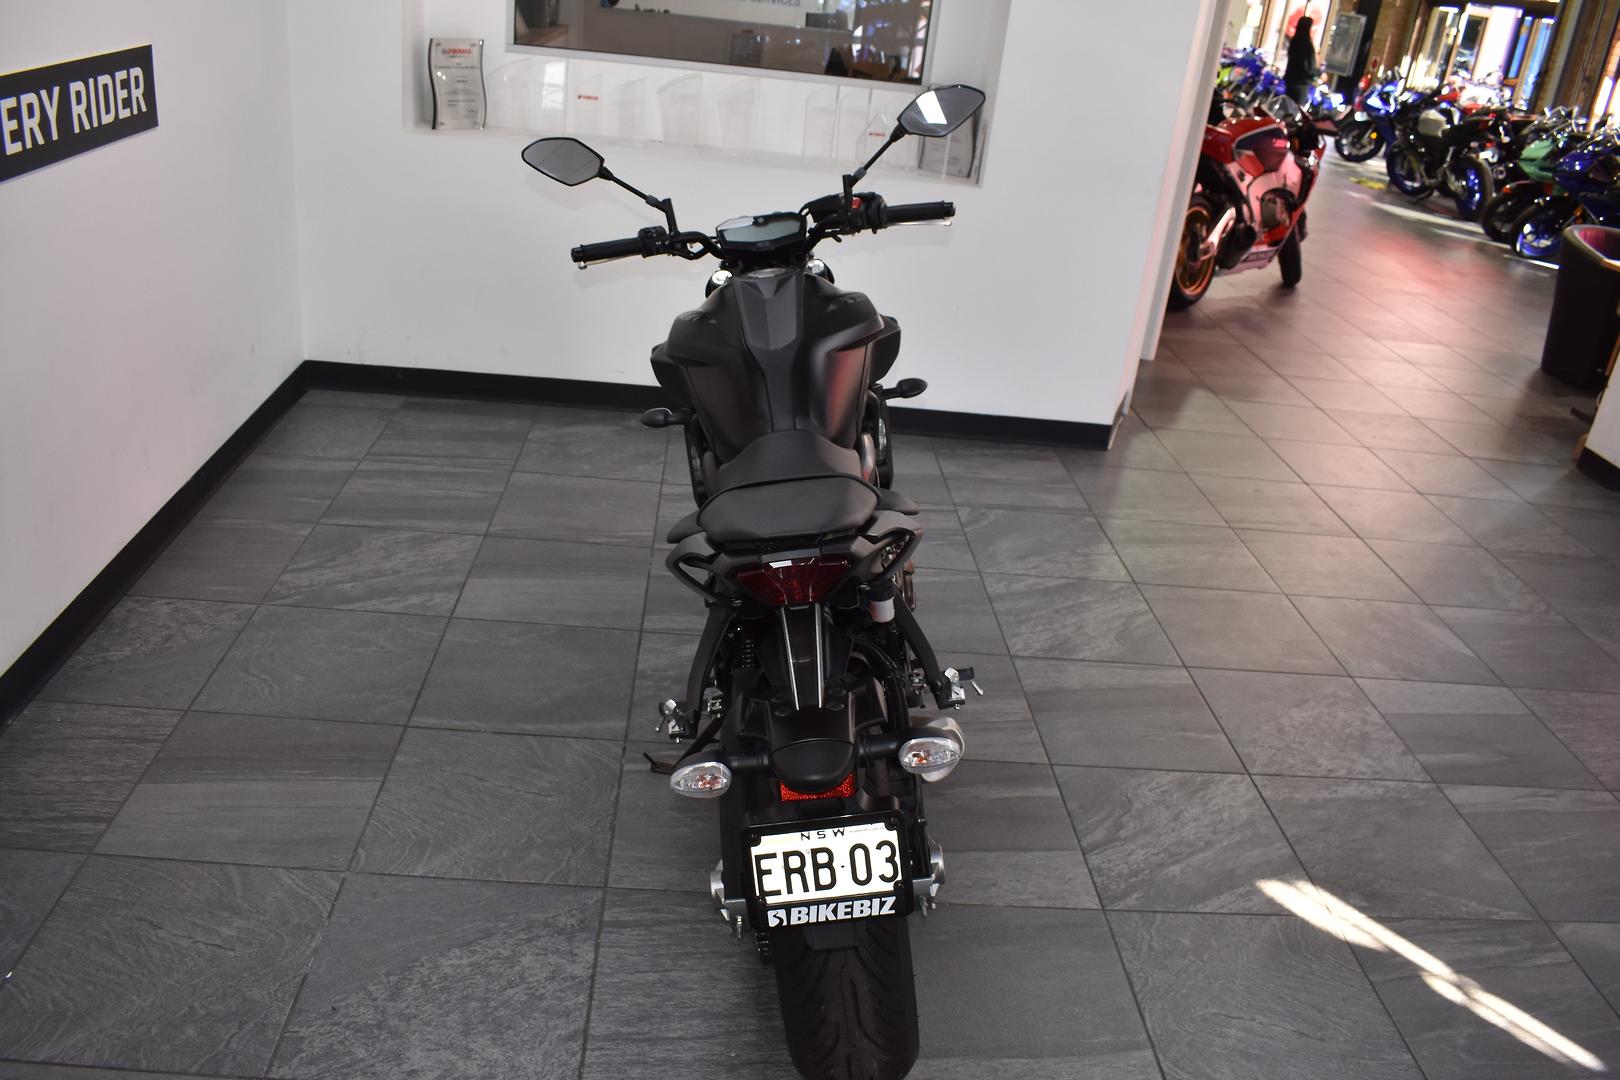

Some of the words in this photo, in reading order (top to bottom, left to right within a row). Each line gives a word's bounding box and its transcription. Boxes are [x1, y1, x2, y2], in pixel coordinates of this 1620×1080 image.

[0, 86, 60, 156] ERY
[69, 66, 148, 134] RIDER
[800, 828, 846, 841] NSW
[754, 847, 837, 897] ERB
[790, 896, 897, 926] BIKEBIZ
